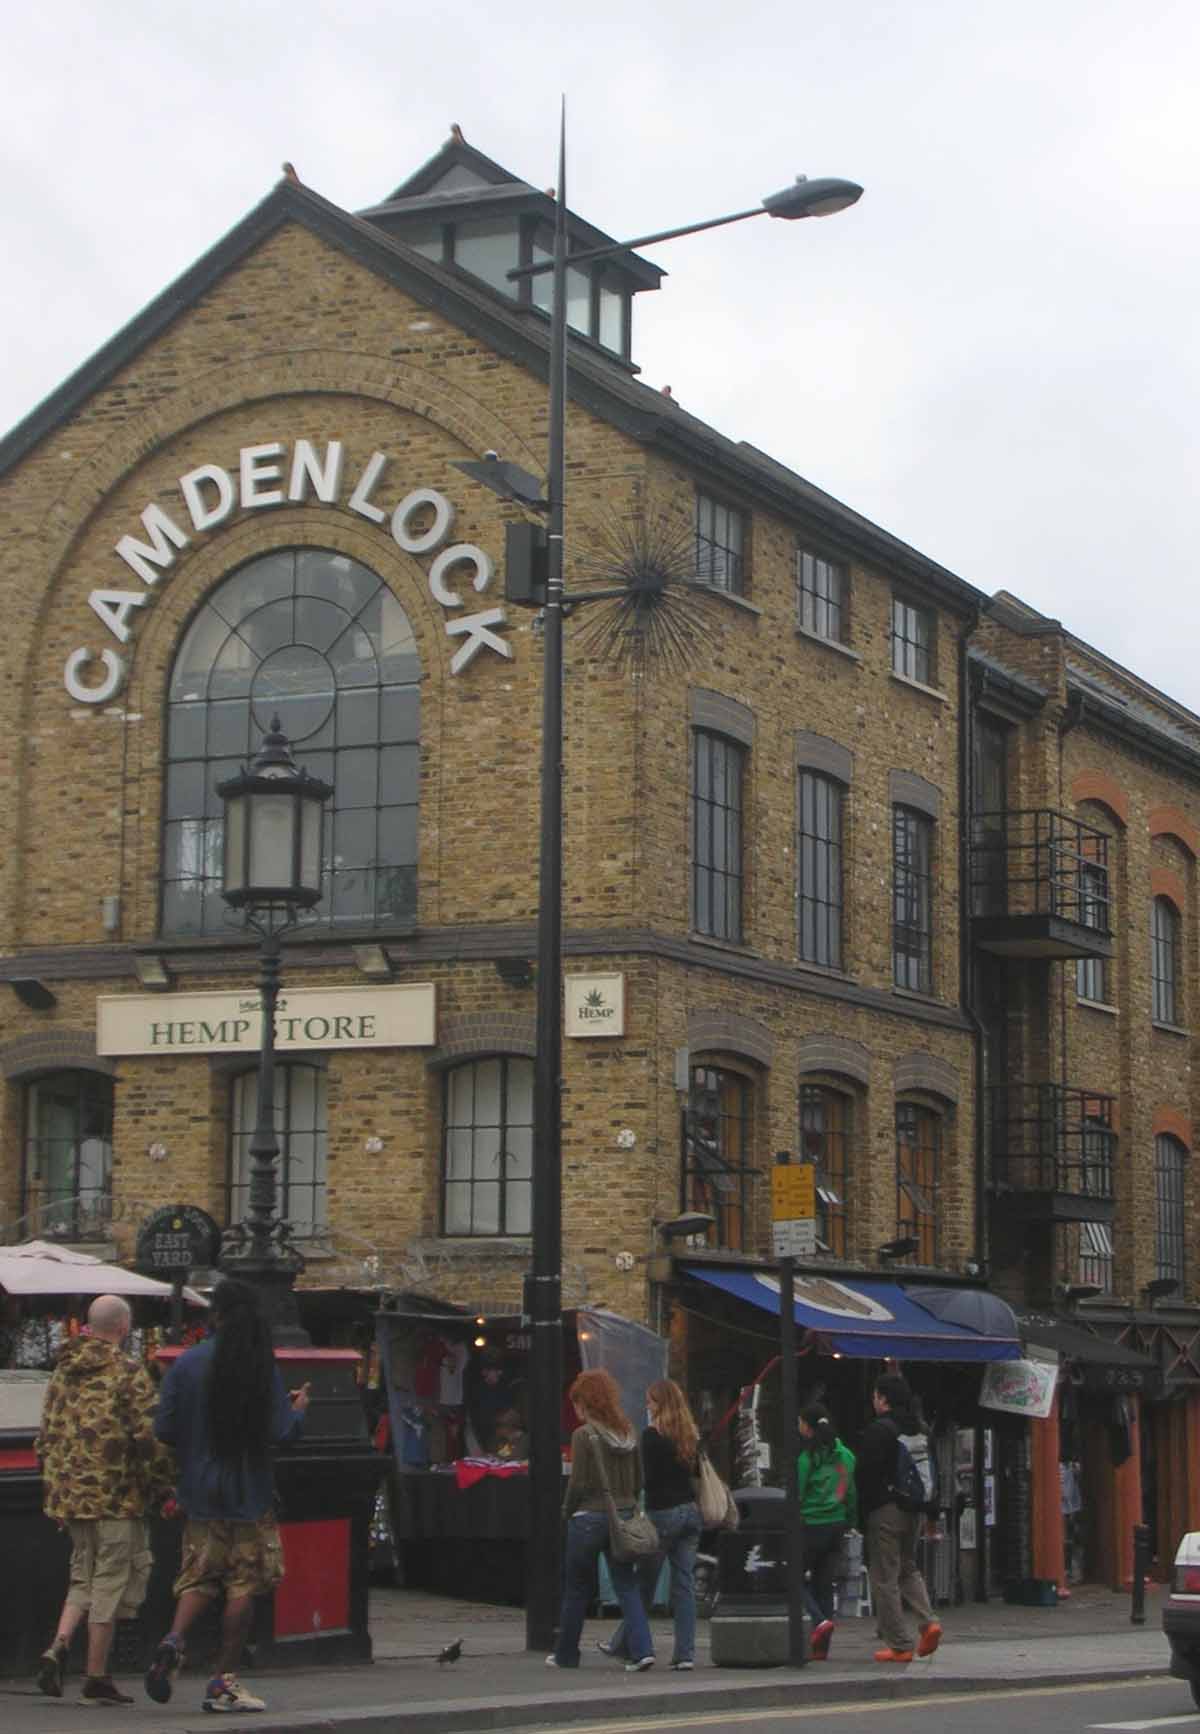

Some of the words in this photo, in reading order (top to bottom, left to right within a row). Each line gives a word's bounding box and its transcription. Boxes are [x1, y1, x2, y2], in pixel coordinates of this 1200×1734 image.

[64, 440, 343, 703] CAMDEN
[348, 451, 513, 675] LOCK
[150, 1019, 250, 1046] HEMP
[155, 1233, 190, 1249] EAST
[151, 1250, 192, 1267] YARD
